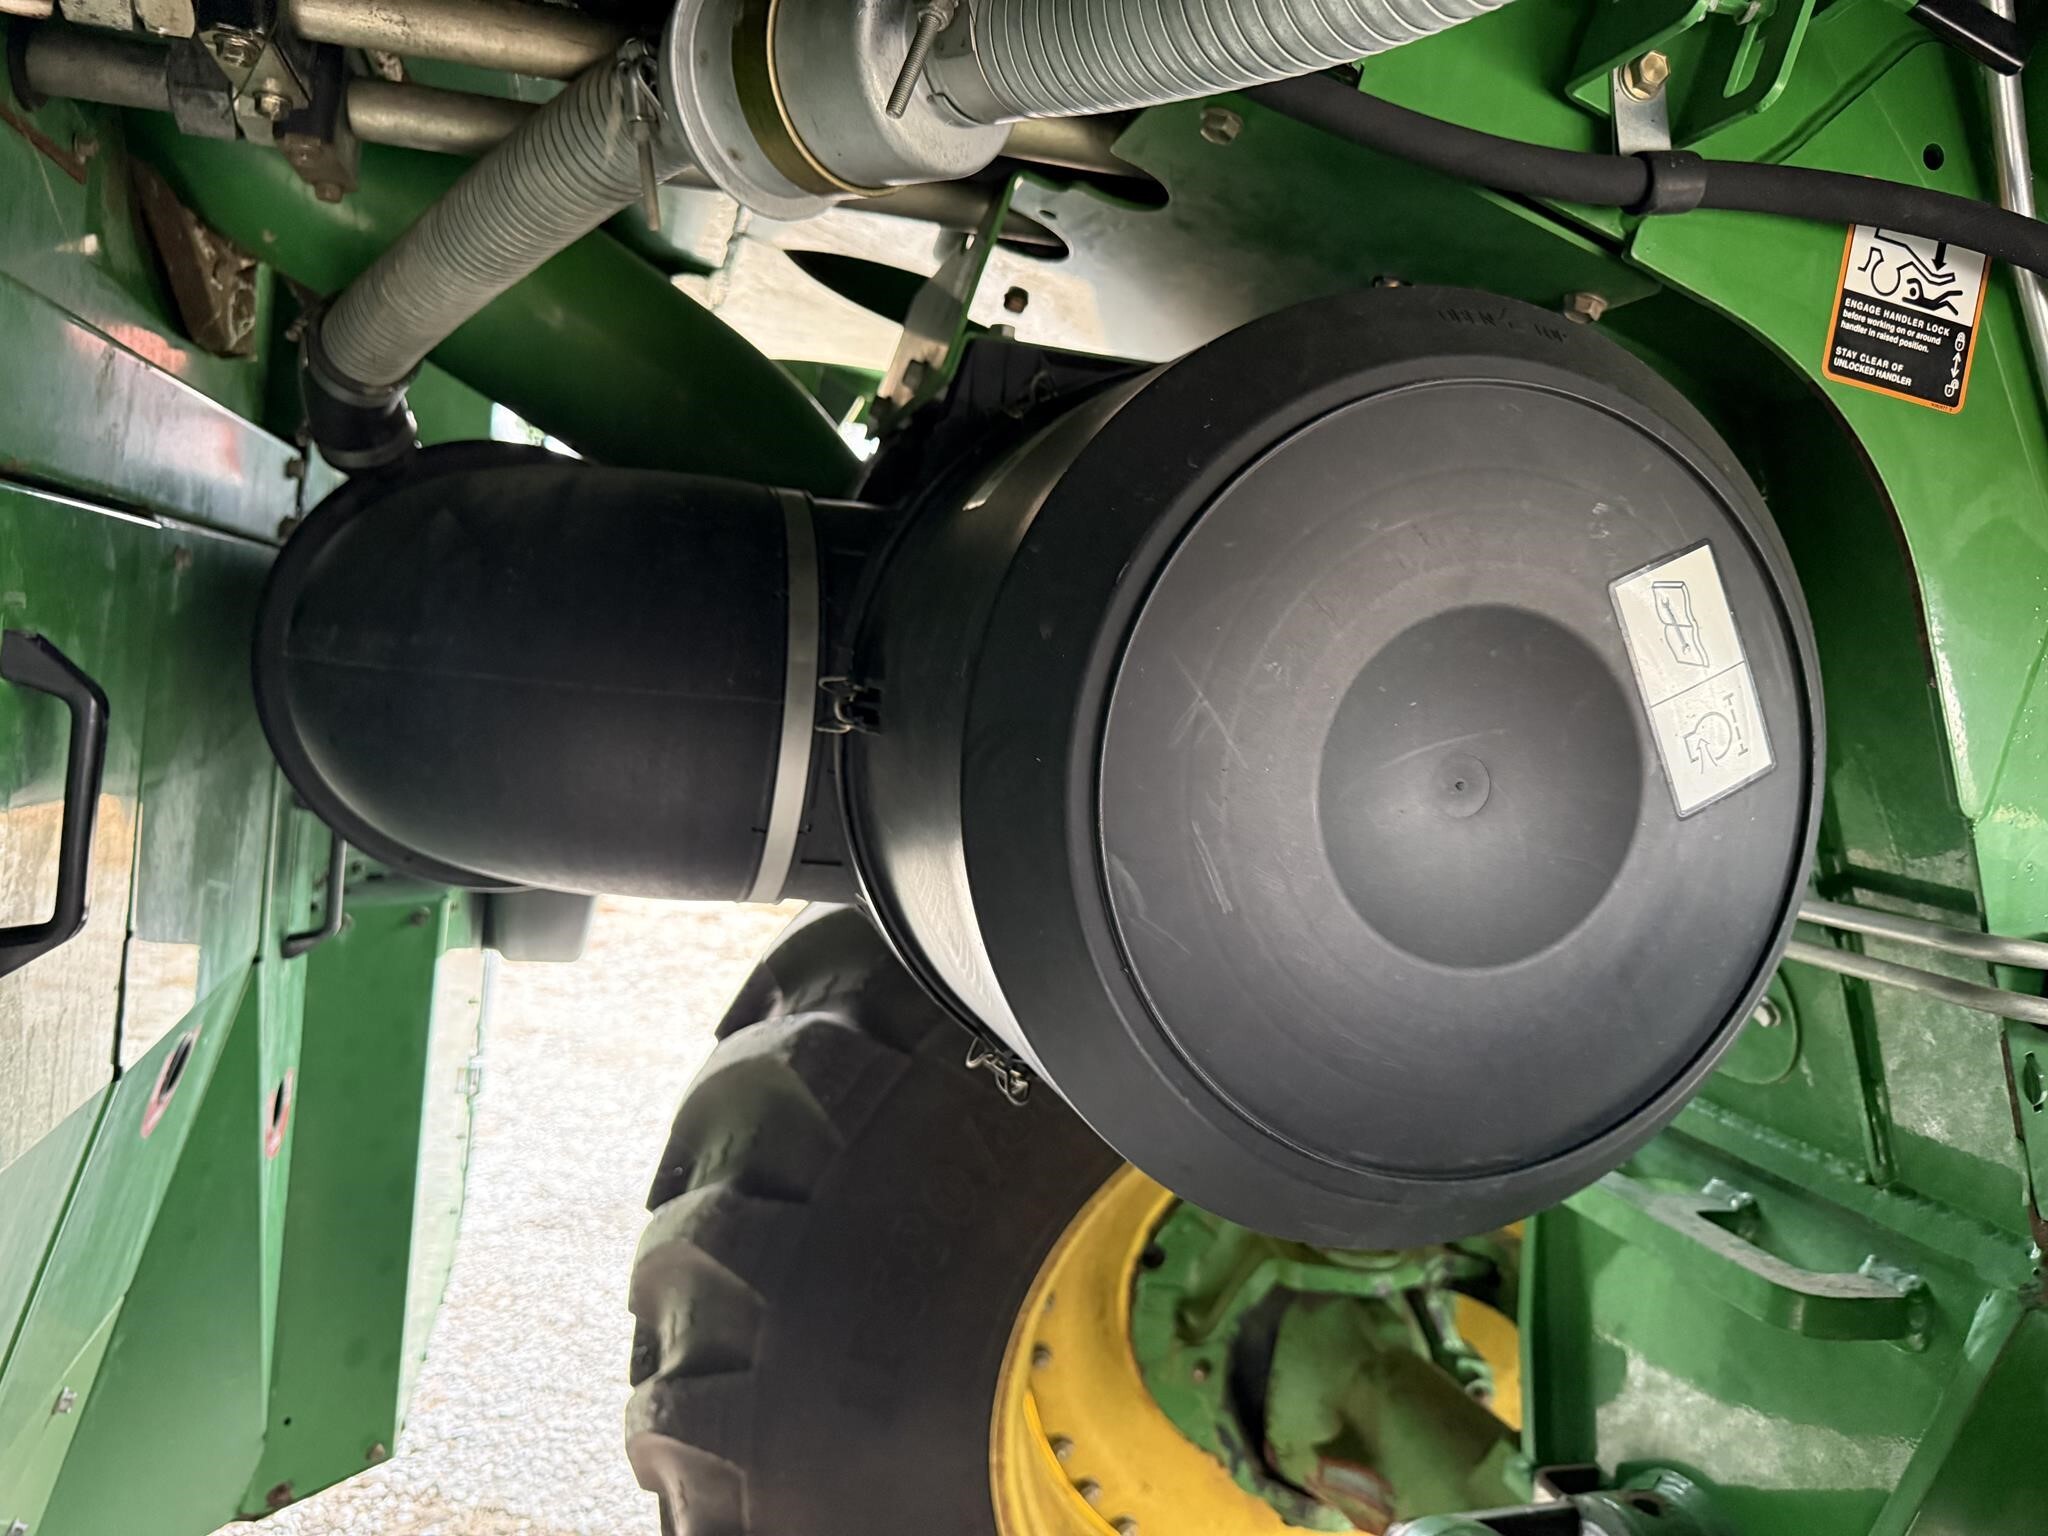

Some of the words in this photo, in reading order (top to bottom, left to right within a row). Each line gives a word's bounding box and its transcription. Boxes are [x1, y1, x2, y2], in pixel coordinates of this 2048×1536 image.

[1843, 309, 1866, 322] before
[1867, 317, 1895, 333] working
[1896, 326, 1906, 335] on
[1906, 328, 1915, 337] or
[1916, 331, 1941, 345] around
[1845, 298, 1881, 315] ENGAGE
[1883, 309, 1924, 328] HANDLER
[1927, 322, 1951, 336] LOCK
[1841, 320, 1867, 335] handler
[1868, 327, 1875, 336] in
[1876, 330, 1898, 344] raised
[1899, 338, 1929, 352] position.
[1834, 357, 1875, 376] UNLOCKED
[1876, 371, 1912, 386] HANDLER
[1836, 346, 1857, 359] STAY
[1860, 354, 1889, 368] CLEAR
[1891, 362, 1904, 372] OF
